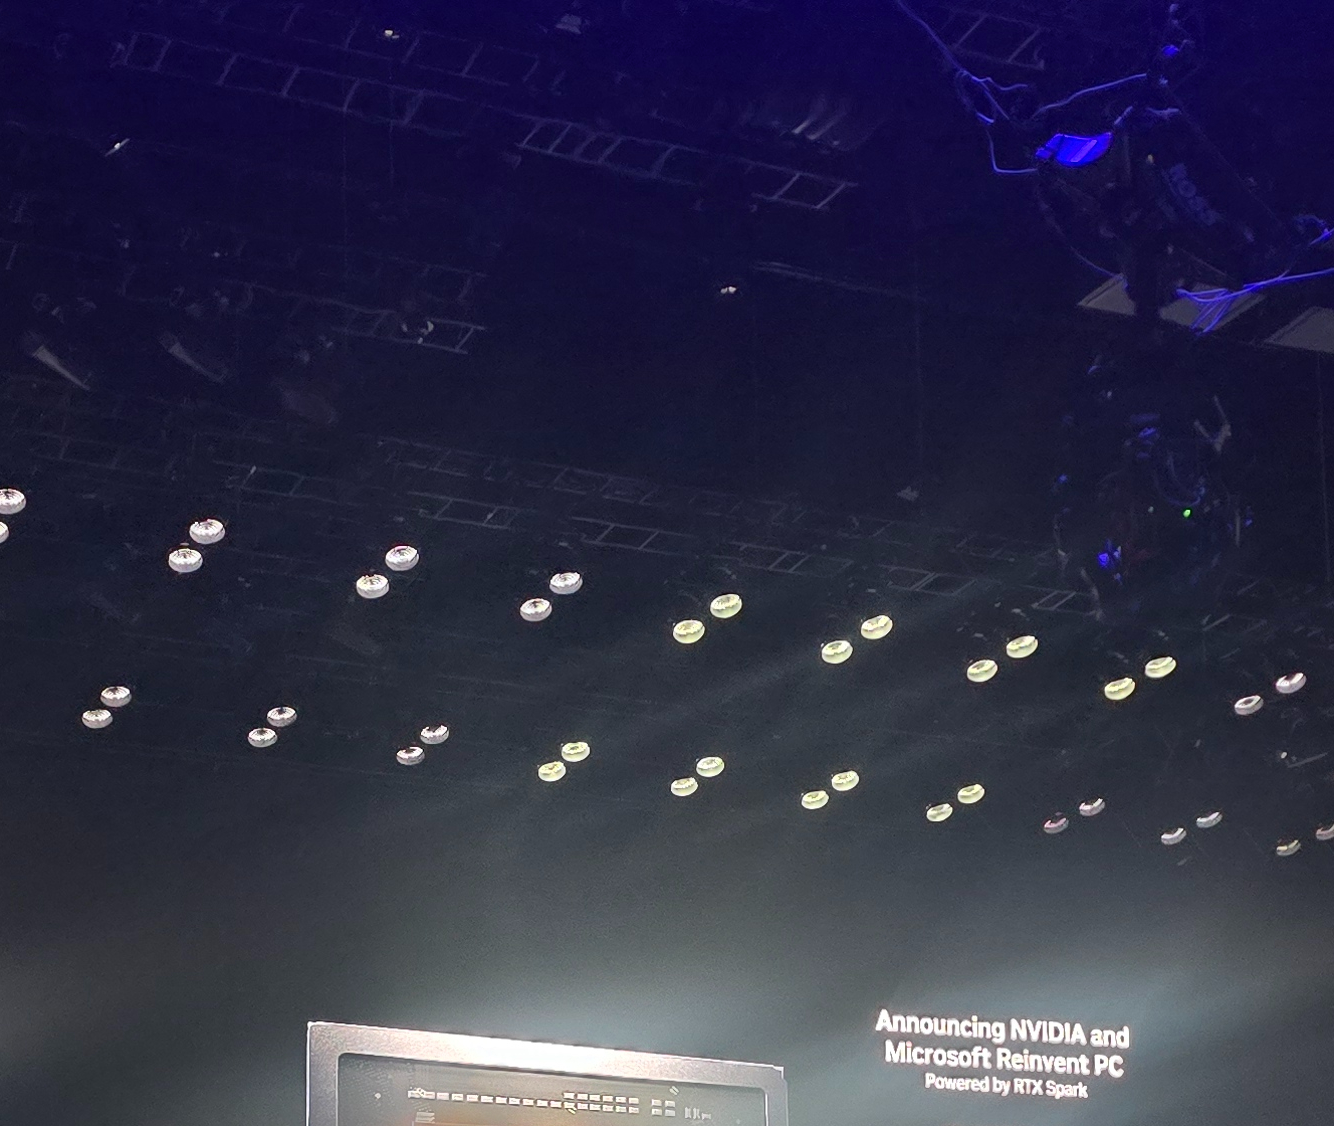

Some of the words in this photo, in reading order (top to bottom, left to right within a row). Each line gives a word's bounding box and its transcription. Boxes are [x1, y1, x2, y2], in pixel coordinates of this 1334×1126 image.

[875, 1009, 1006, 1043] Announcing
[1010, 1018, 1087, 1046] NVIDIA
[1090, 1026, 1130, 1049] and
[884, 1039, 992, 1070] Microsoft
[996, 1047, 1090, 1076] Reinvent
[1094, 1055, 1124, 1078] PC
[925, 1072, 989, 1093] Powered
[992, 1075, 1011, 1096] by
[1013, 1078, 1043, 1095] RTX
[1046, 1080, 1088, 1099] Spark
